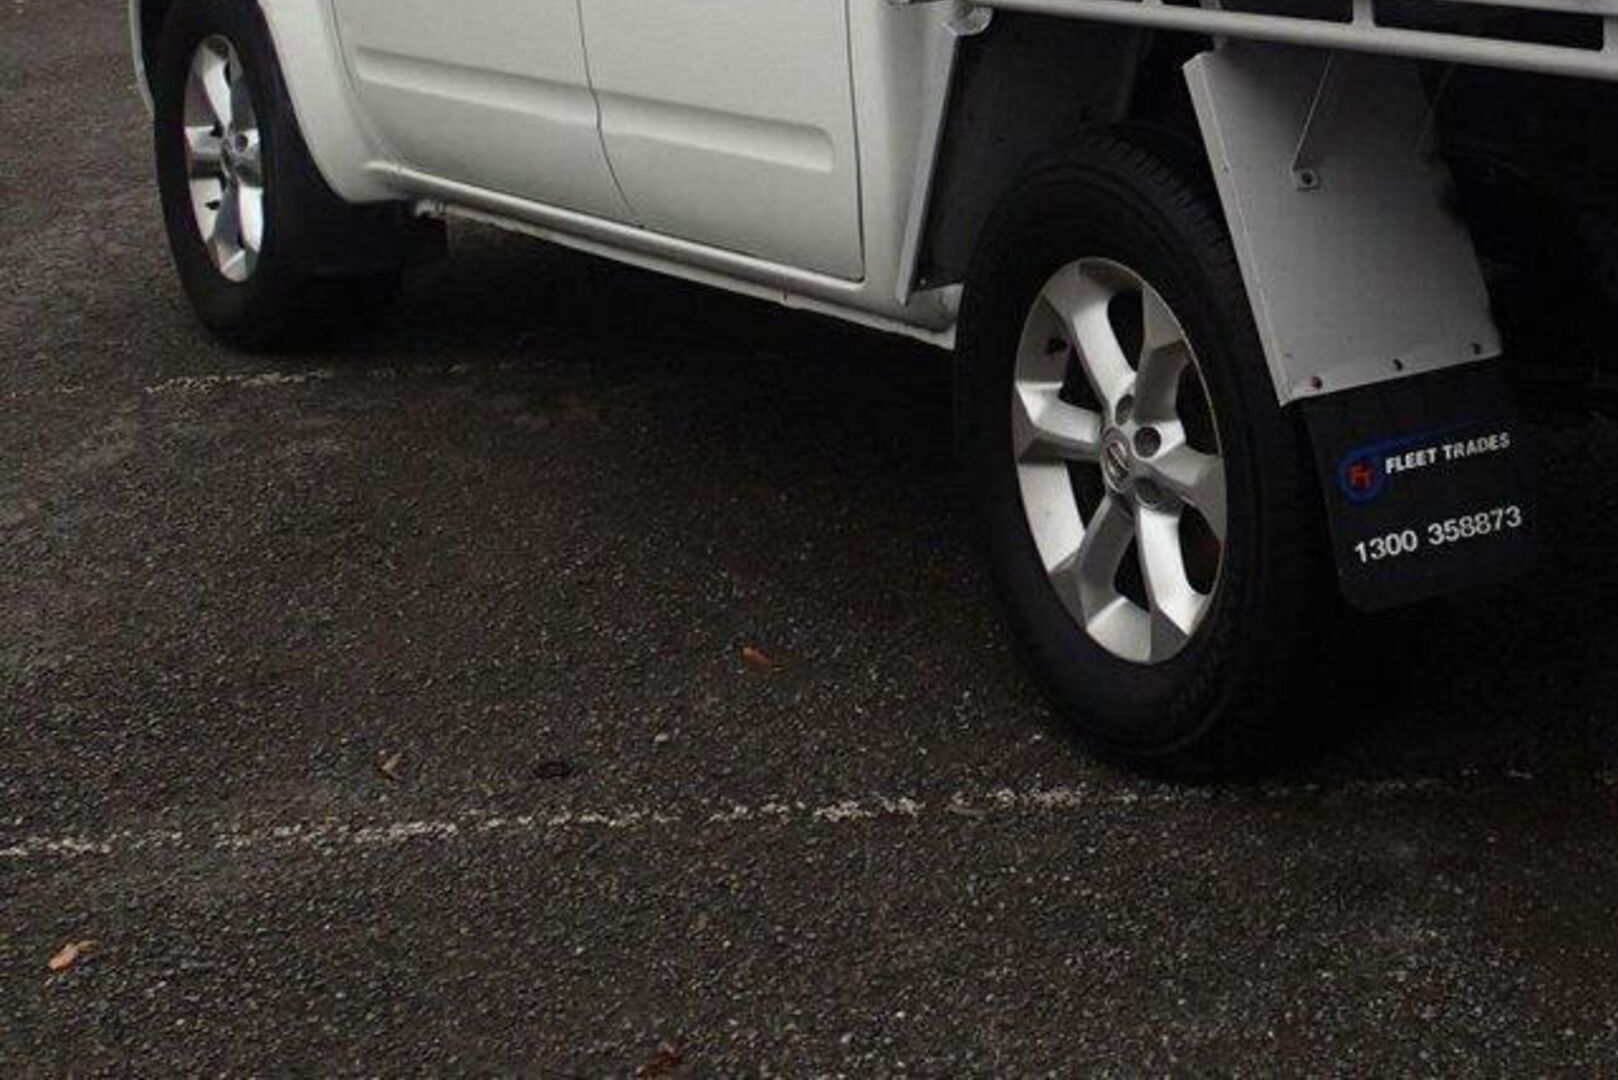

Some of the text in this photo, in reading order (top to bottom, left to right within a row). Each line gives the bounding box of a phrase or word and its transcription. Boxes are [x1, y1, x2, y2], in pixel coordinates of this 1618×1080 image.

[1385, 431, 1511, 474] FLEET TRADES
[1354, 504, 1523, 563] 1300 358873
